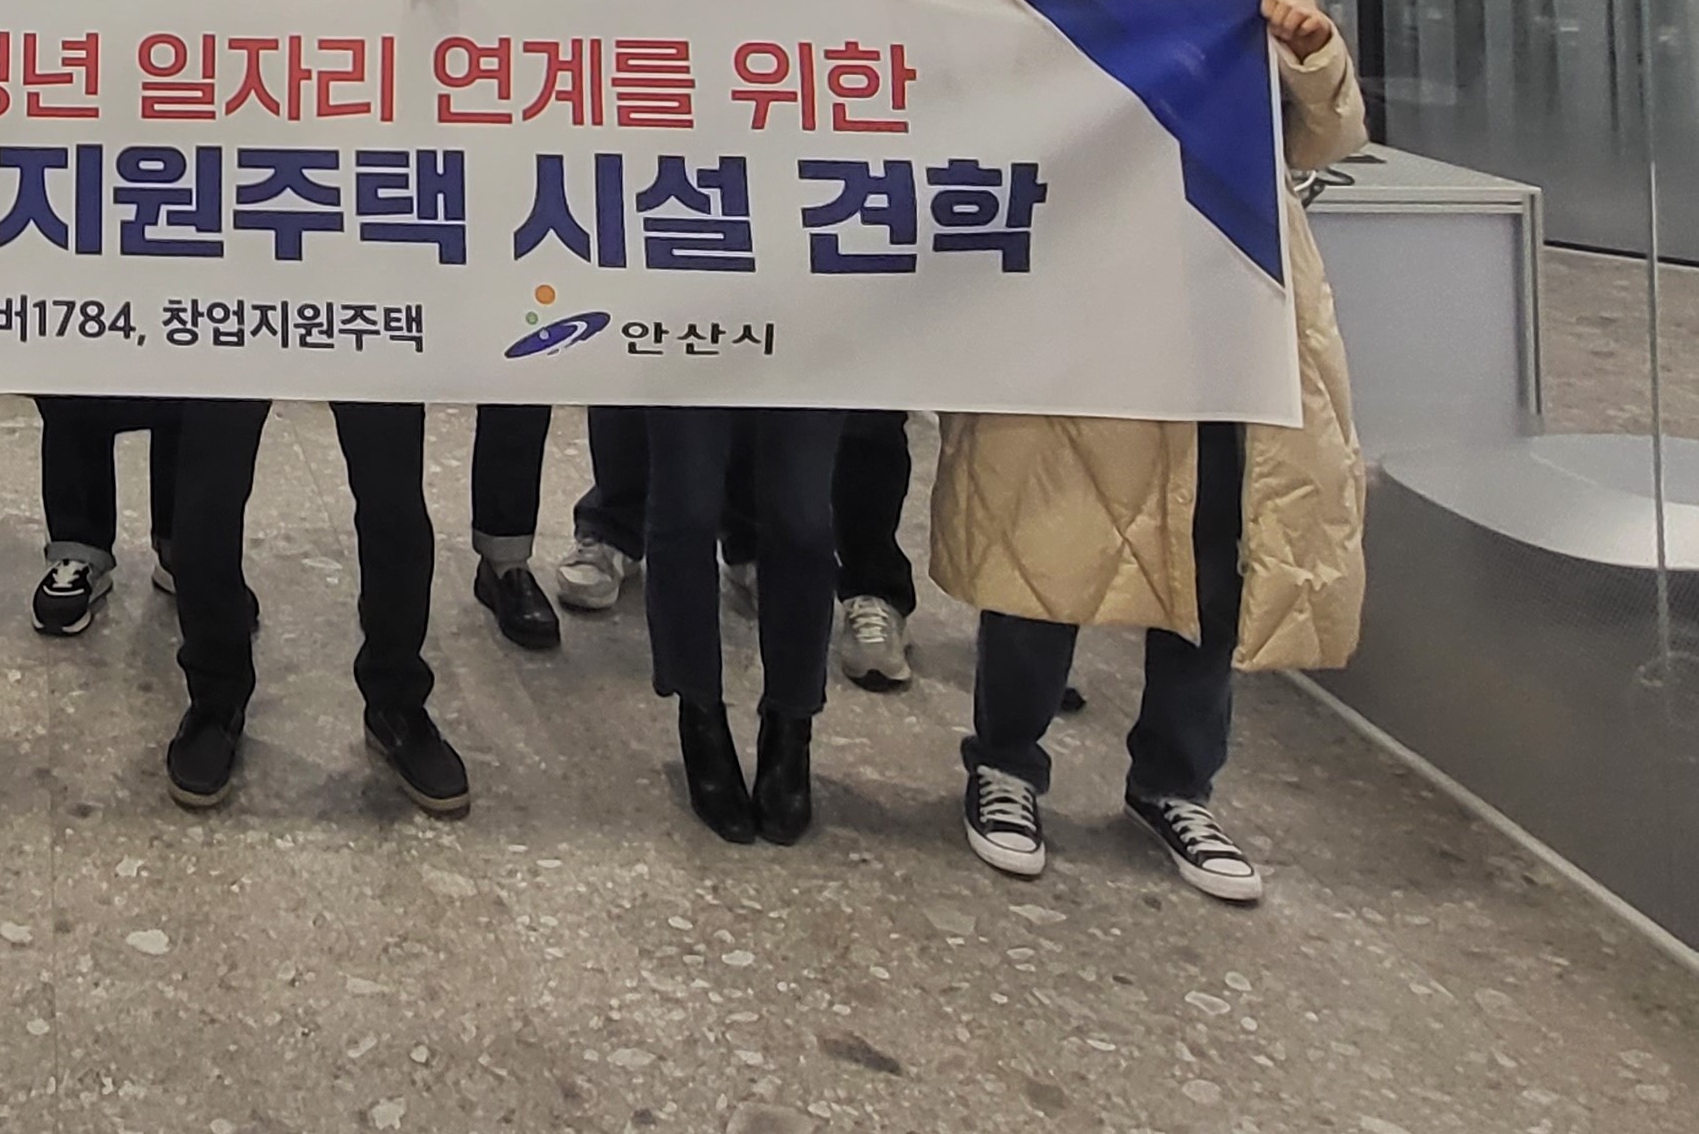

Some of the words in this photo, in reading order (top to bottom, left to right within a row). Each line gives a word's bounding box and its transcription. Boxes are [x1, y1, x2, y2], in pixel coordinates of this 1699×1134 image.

[137, 33, 396, 123] 일자리
[433, 35, 695, 129] 연계를
[730, 40, 917, 133] 위한
[513, 153, 757, 273] 시설
[797, 158, 1049, 275] 견학
[162, 298, 424, 353] 창업지원주택
[621, 320, 775, 356] 안산시
